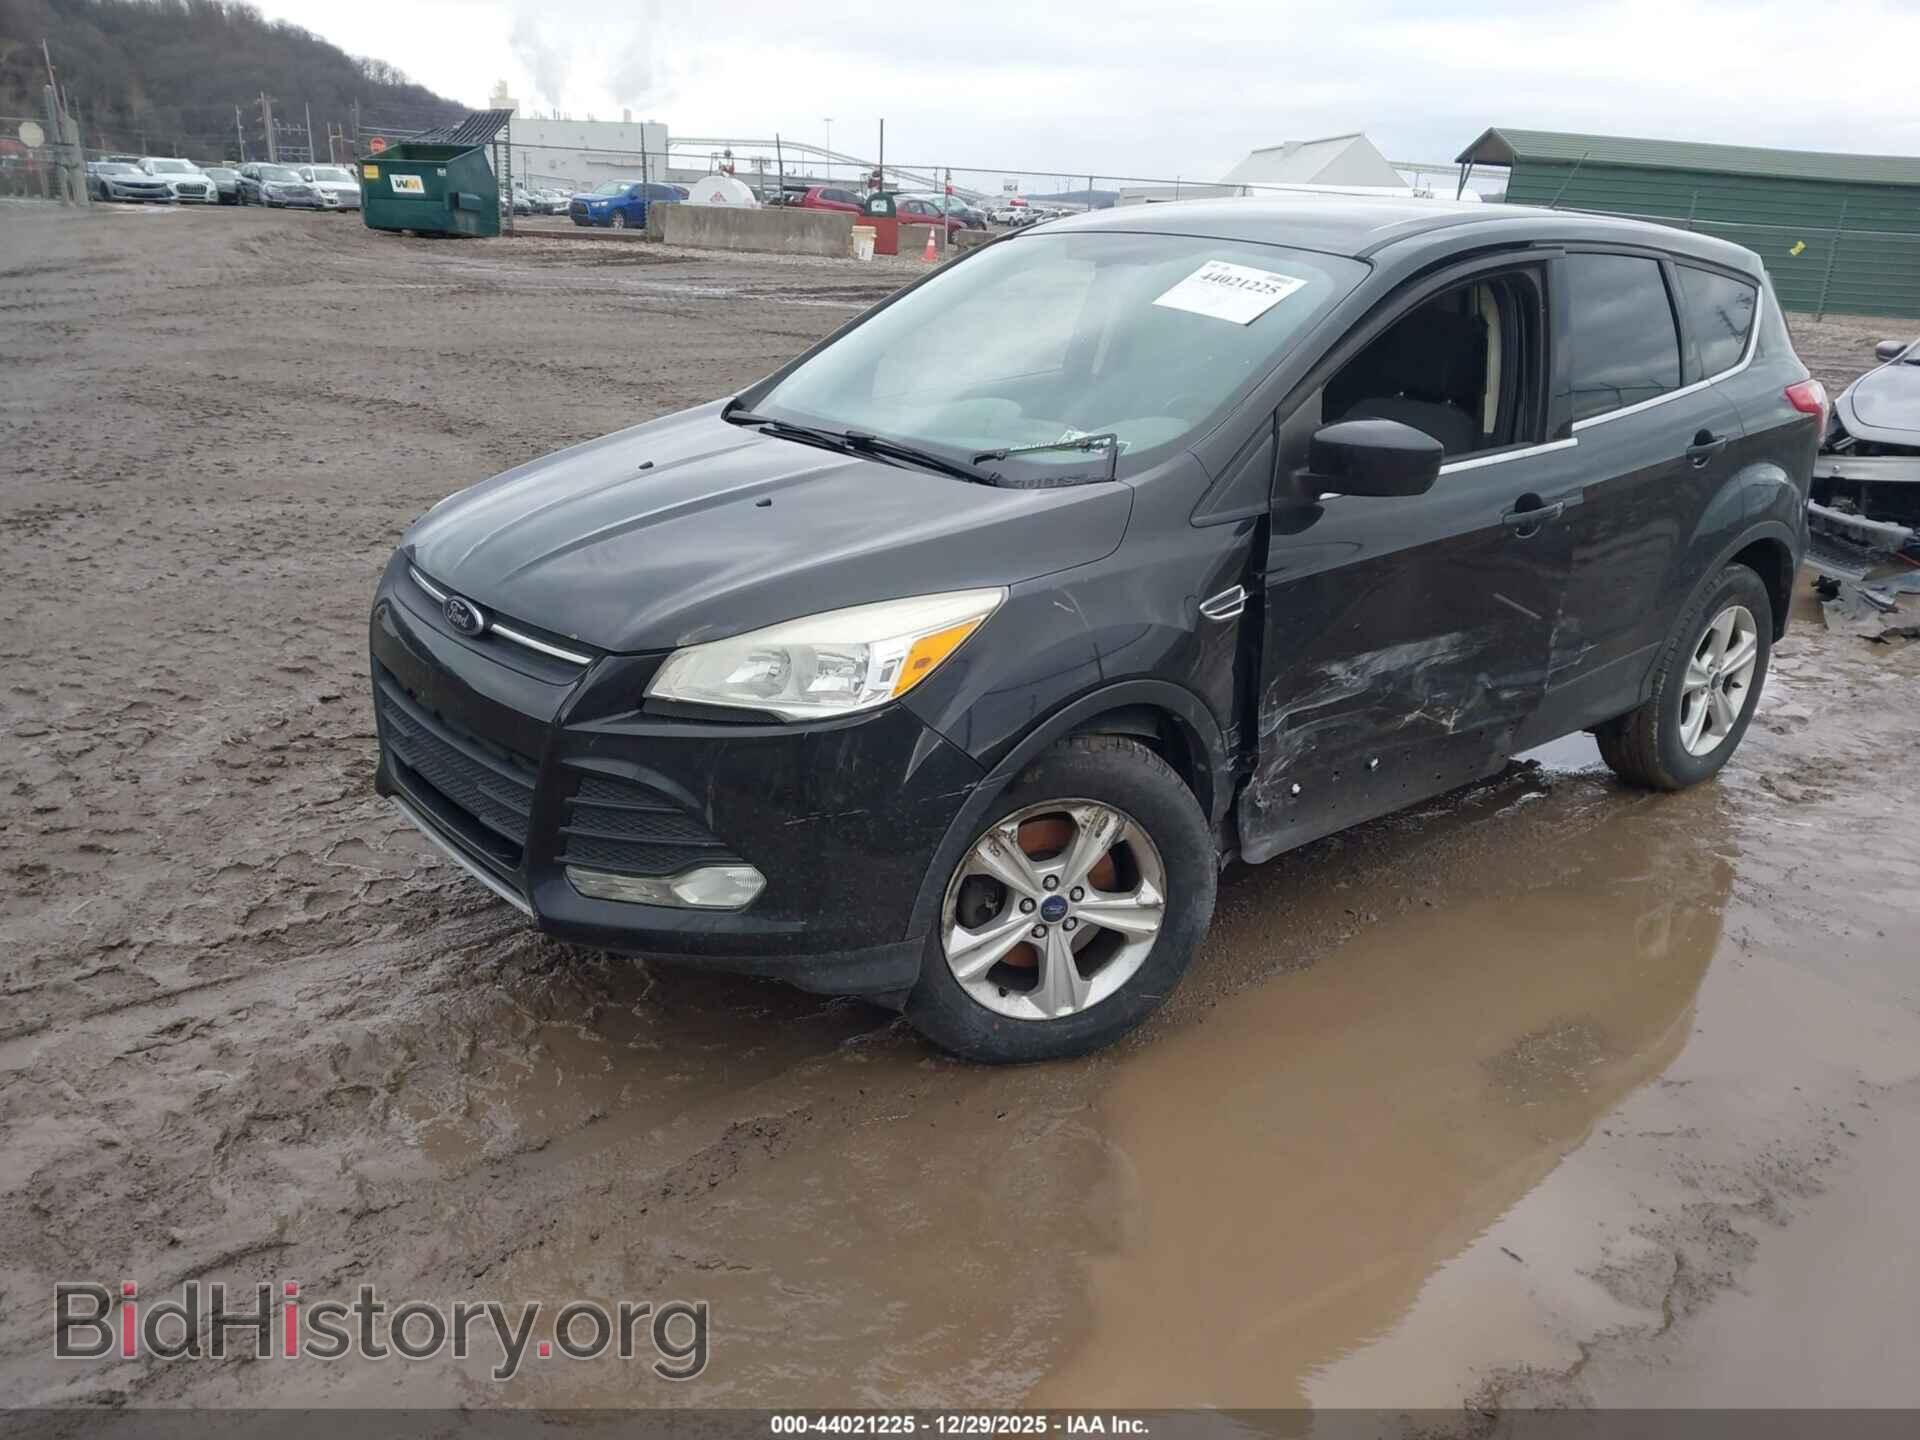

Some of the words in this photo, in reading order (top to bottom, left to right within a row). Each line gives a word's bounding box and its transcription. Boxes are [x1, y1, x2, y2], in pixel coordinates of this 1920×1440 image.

[395, 179, 420, 190] WM
[1200, 271, 1282, 295] 44021225
[447, 600, 470, 628] Ford
